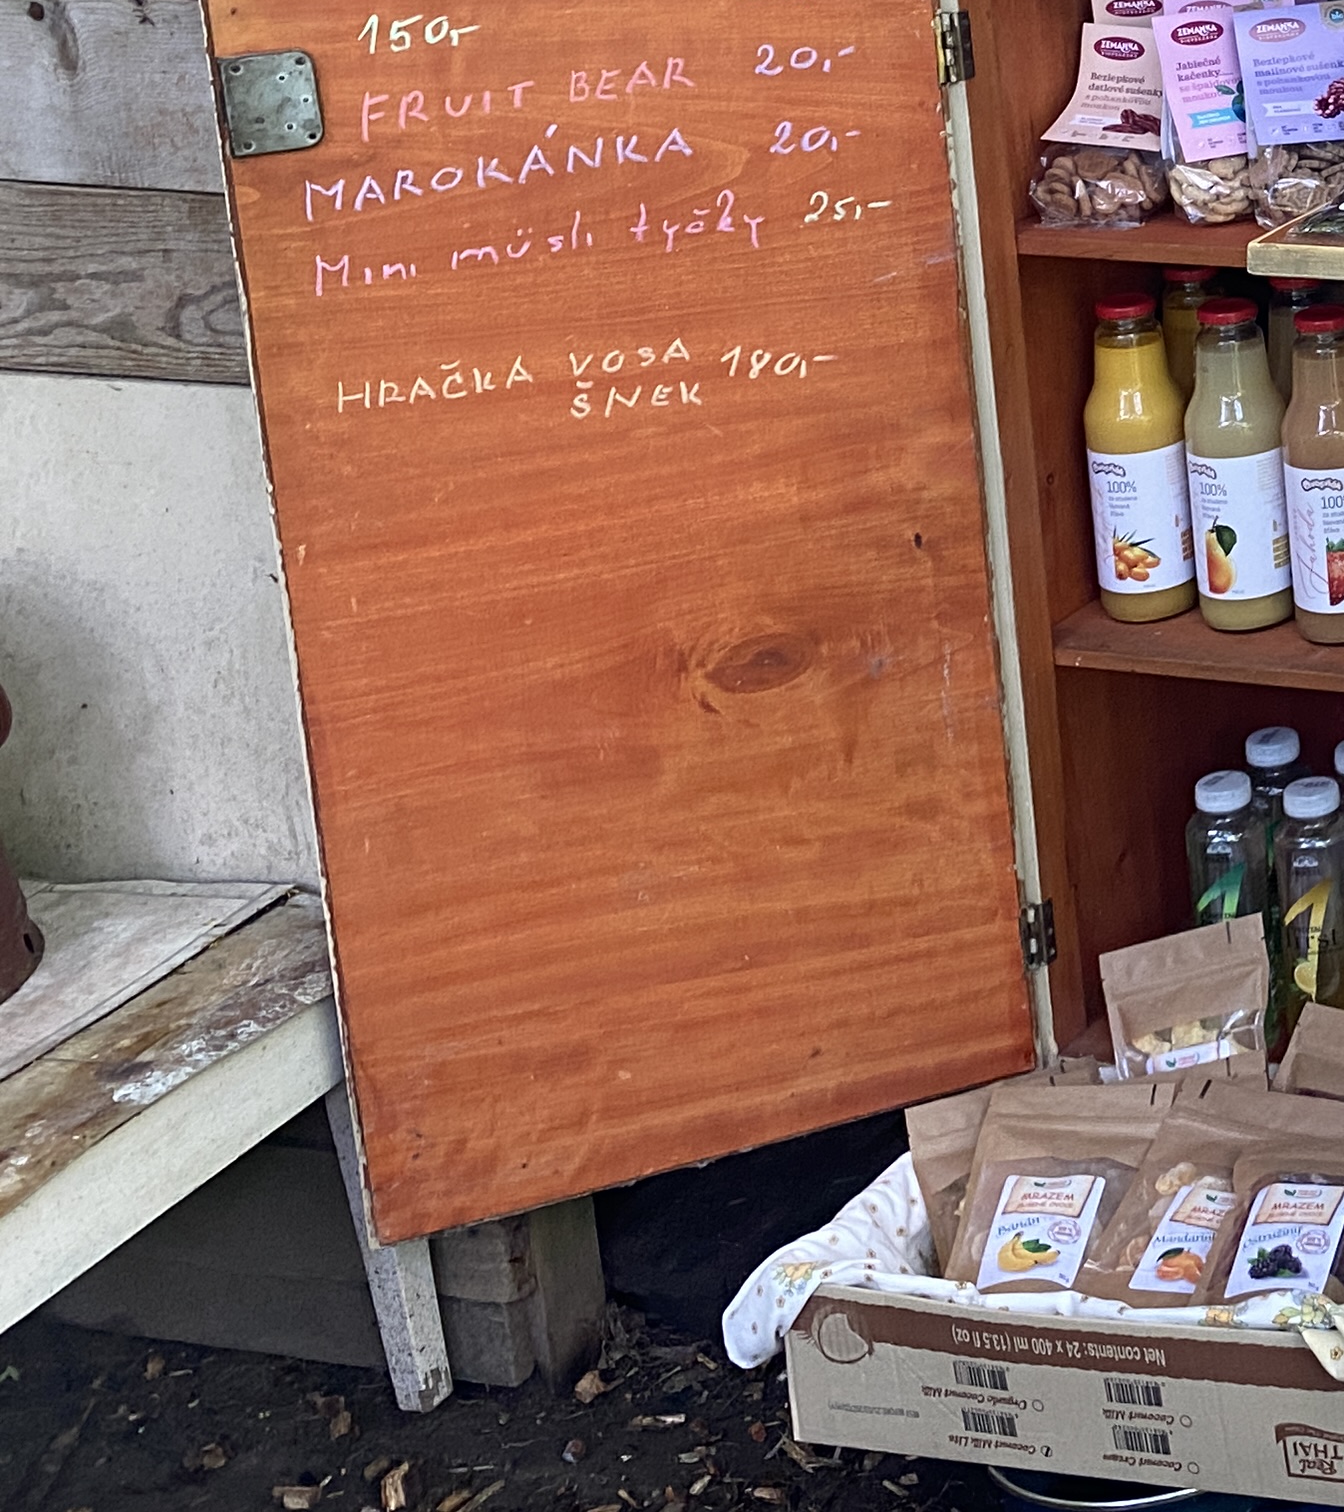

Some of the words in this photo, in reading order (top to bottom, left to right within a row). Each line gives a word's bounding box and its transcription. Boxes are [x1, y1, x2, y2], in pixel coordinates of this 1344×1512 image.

[1176, 24, 1217, 38] ZEMANKA
[1255, 22, 1300, 34] ZEMANKA
[1176, 56, 1221, 70] Jablečné
[1090, 72, 1145, 84] Bezlepkové
[1178, 70, 1221, 82] kačenky
[361, 79, 536, 142] FRUIT
[569, 57, 696, 104] BEAR
[755, 43, 855, 77] 20,-
[305, 123, 694, 221] MAROKÁNKA
[770, 120, 861, 156] 20,-
[315, 254, 418, 297] Mini
[451, 211, 594, 271] müsli
[805, 191, 892, 223] 25,-
[336, 356, 532, 412] HRAČKA
[569, 337, 692, 379] VOSA
[720, 344, 839, 380] 180,-
[571, 380, 703, 419] ŠNEK
[1106, 480, 1137, 495] 100%
[1020, 1191, 1075, 1202] MRAZEM
[1270, 1201, 1325, 1211] MRAZEM
[951, 1324, 969, 1342] oz)
[1014, 1334, 1029, 1346] ml
[982, 1332, 1012, 1352] (13.5
[1031, 1337, 1051, 1354] 400
[1067, 1342, 1080, 1357] 24
[1084, 1343, 1140, 1359] contents:
[1145, 1349, 1166, 1367] Net
[1129, 1412, 1174, 1424] Coconut
[1293, 1441, 1343, 1459] THAI
[1141, 1459, 1182, 1471] Coconut
[1300, 1459, 1336, 1474] Real
